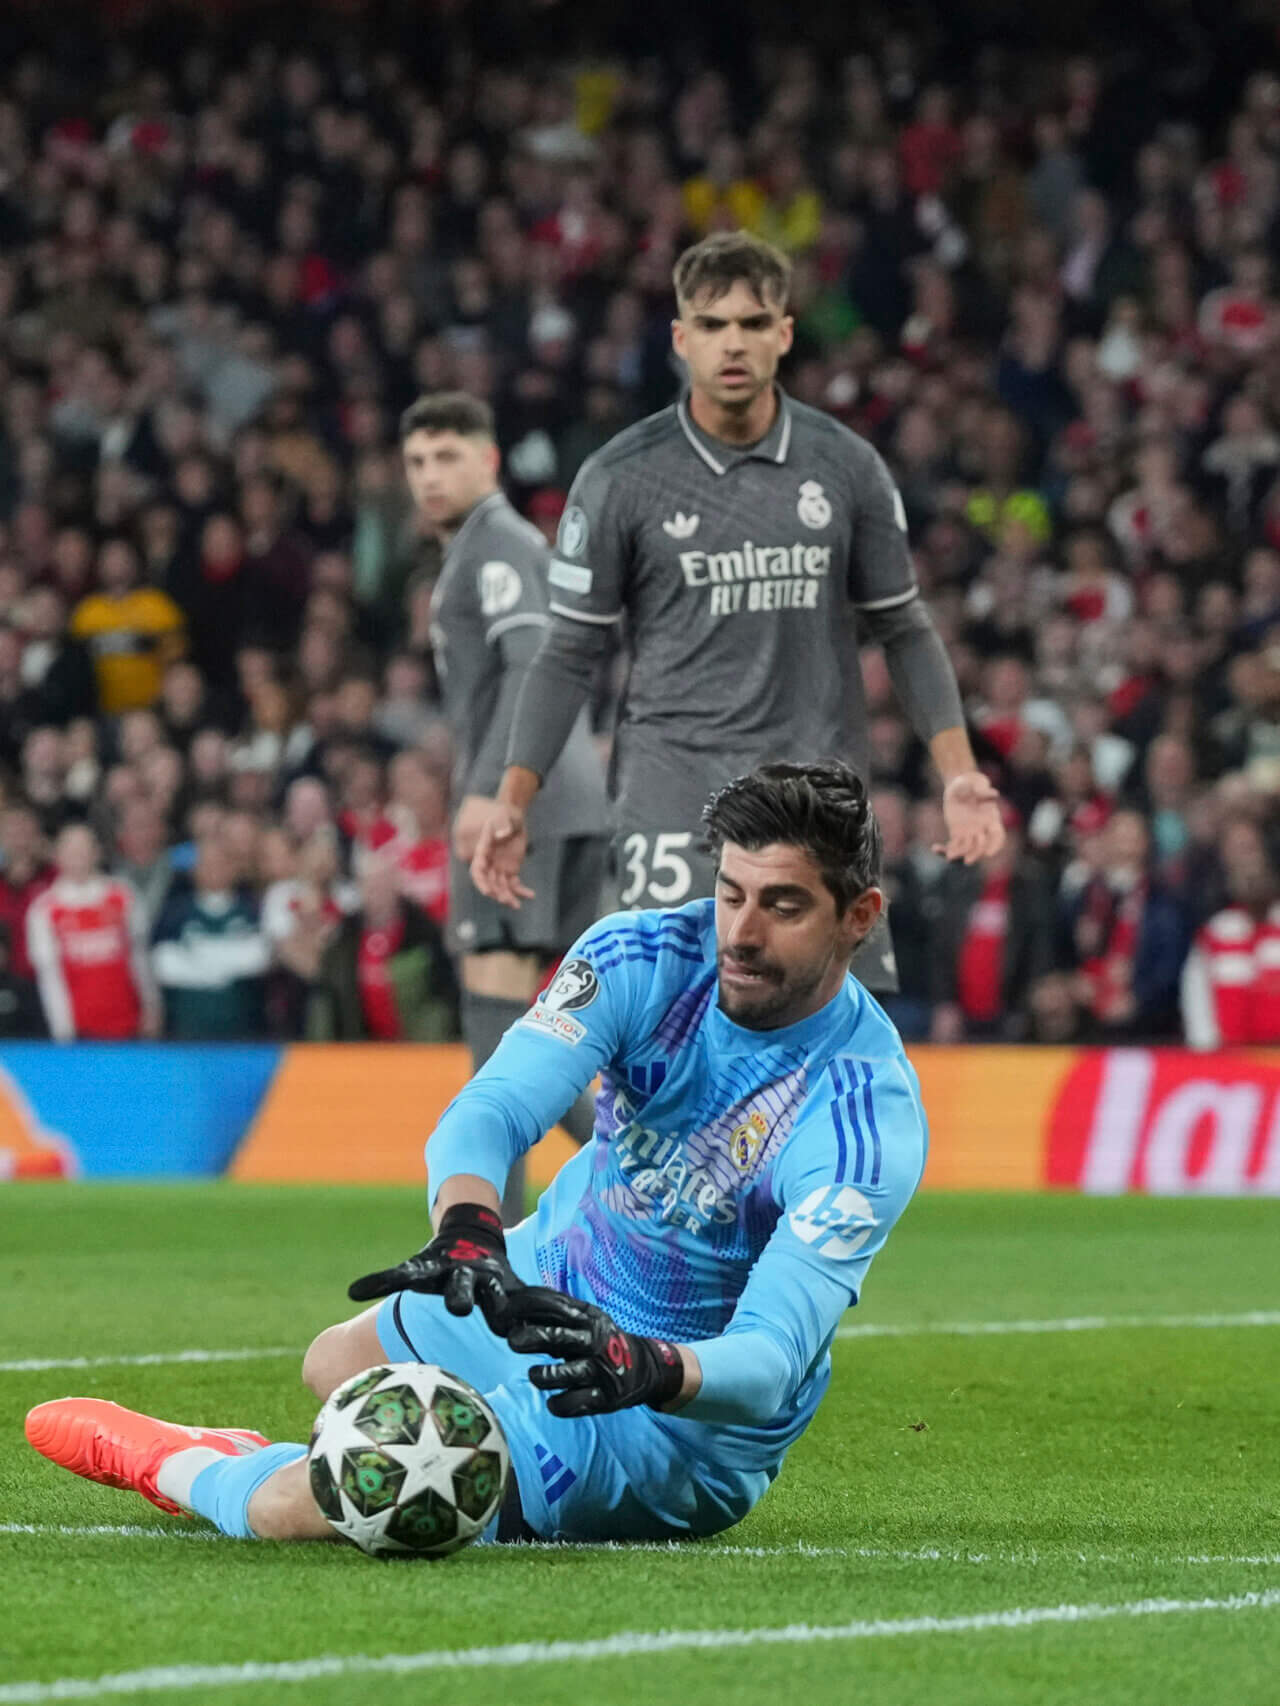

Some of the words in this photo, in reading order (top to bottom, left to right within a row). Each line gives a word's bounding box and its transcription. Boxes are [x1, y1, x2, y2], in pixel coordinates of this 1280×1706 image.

[710, 583, 744, 616] FLY
[748, 579, 819, 612] BETTER
[621, 832, 692, 905] 35
